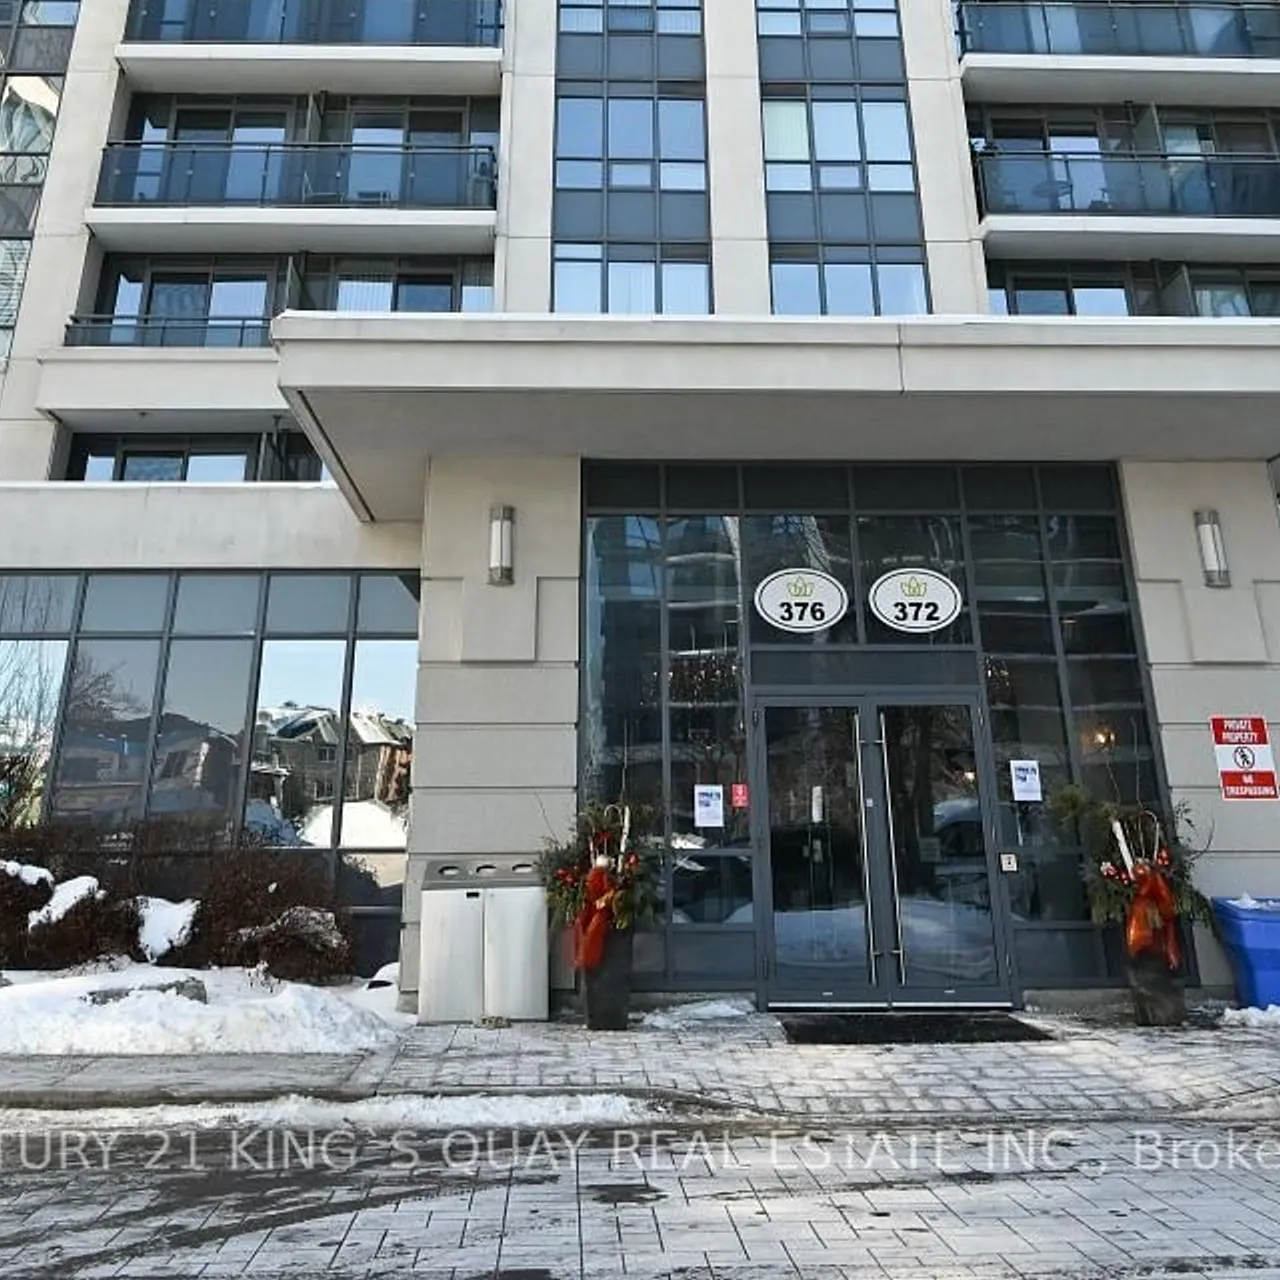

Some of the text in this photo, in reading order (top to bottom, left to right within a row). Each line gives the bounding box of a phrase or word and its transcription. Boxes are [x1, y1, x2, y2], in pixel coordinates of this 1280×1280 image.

[779, 602, 825, 621] 376
[893, 602, 940, 621] 372
[1222, 732, 1259, 743] PROPERTY
[1225, 786, 1275, 796] TRESPASSING
